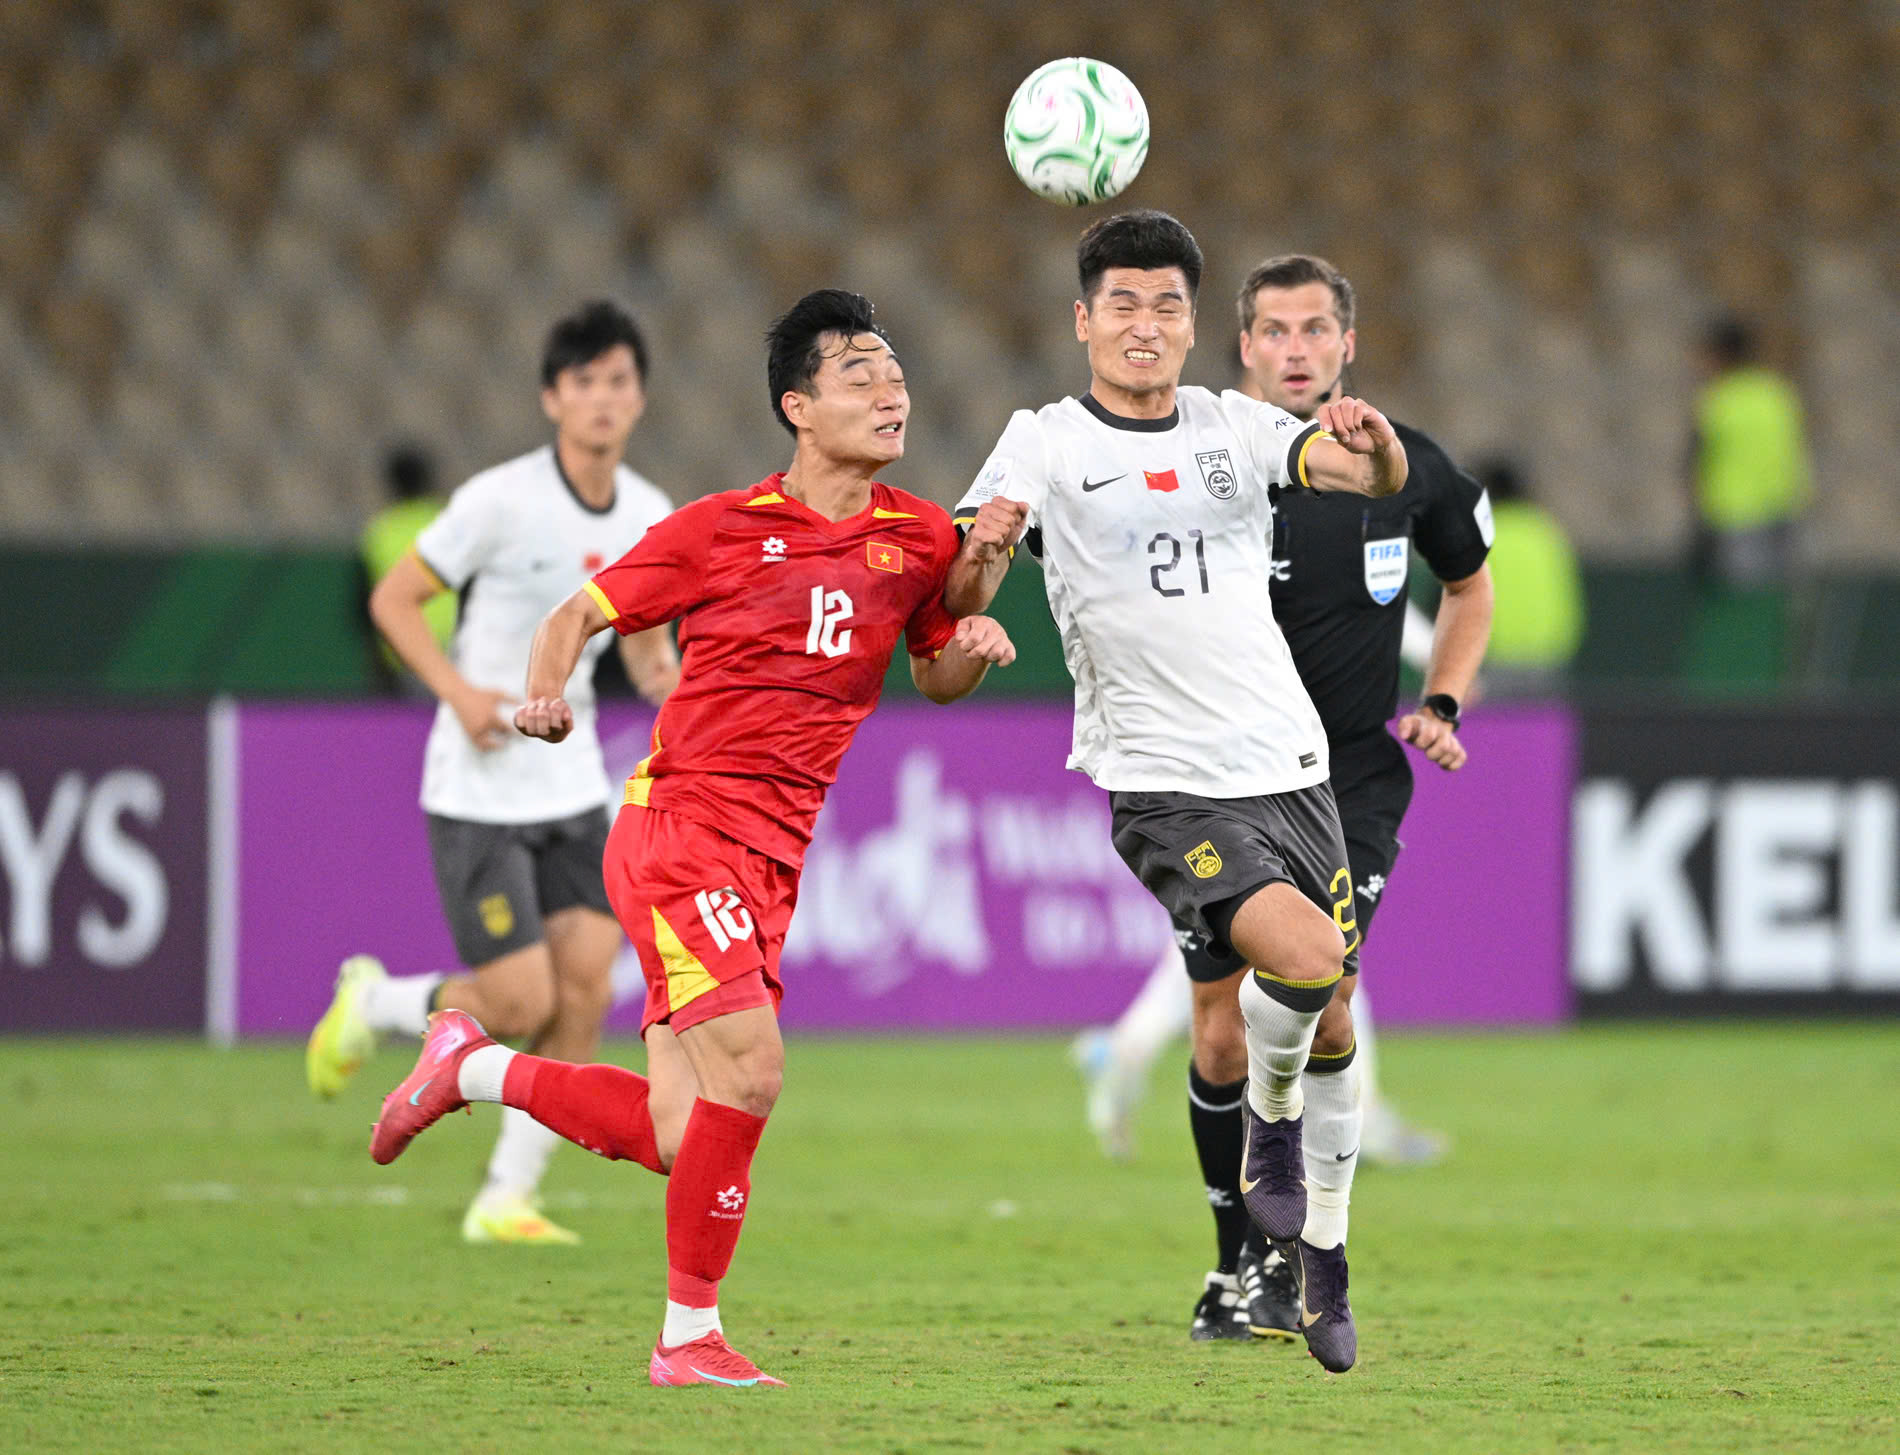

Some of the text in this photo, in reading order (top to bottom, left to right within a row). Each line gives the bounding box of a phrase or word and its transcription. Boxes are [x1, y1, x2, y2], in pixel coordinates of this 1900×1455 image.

[1199, 452, 1228, 465] CFA
[1147, 528, 1209, 598] 21
[1370, 544, 1402, 561] FIFA
[806, 585, 854, 659] 12
[0, 769, 170, 968] YS
[694, 885, 755, 953] 12
